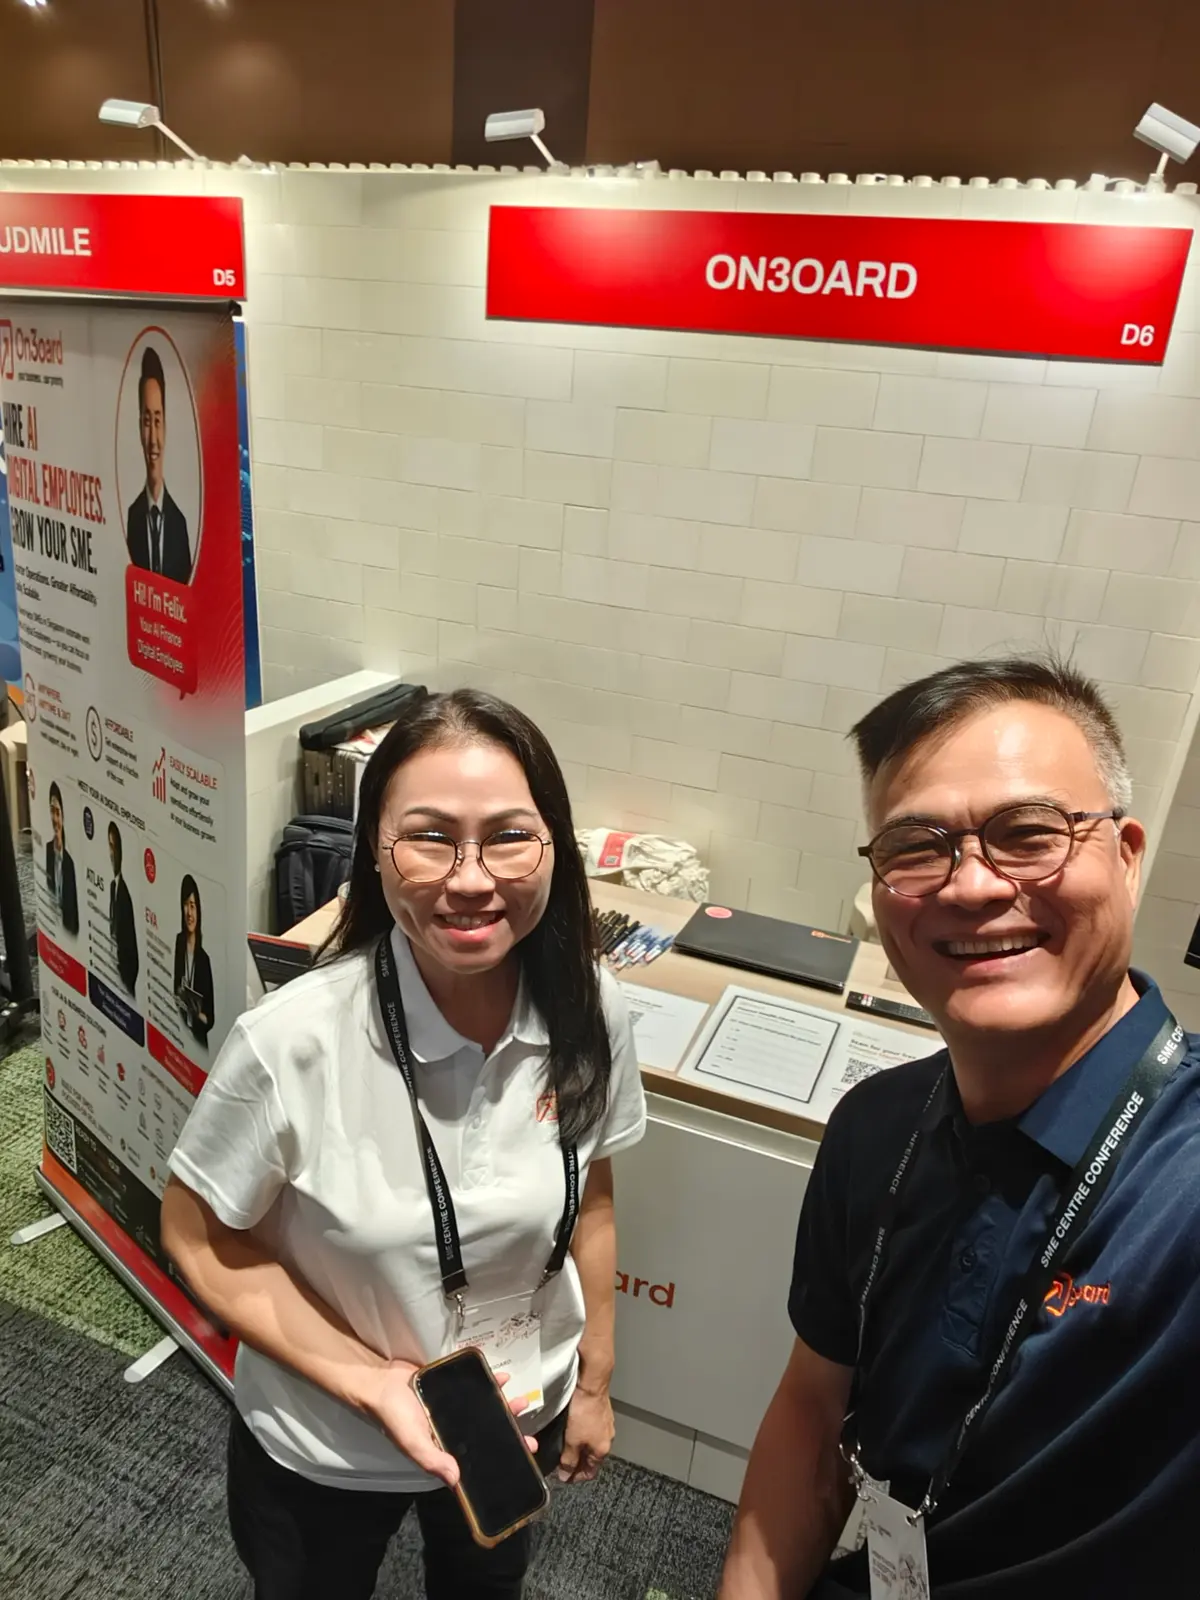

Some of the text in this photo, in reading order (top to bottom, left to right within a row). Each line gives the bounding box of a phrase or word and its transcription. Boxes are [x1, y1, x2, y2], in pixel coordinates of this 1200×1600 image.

[212, 268, 236, 287] D5
[705, 253, 918, 299] ON3OARD
[1120, 323, 1155, 347] D6
[27, 406, 38, 451] AI
[42, 463, 106, 525] EMPLOYEES.
[37, 515, 68, 564] YOUR
[71, 524, 98, 575] SME.
[134, 580, 188, 623] Hi! I'm Felix.
[387, 1001, 407, 1063] CONFERENCE
[1156, 1038, 1177, 1066] SME
[427, 1146, 447, 1210] CONFERENCE
[1040, 1090, 1145, 1269] SME CENTRE CONFERENCE
[440, 1209, 453, 1244] CENTRE
[989, 1298, 1029, 1384] CONFERENCE
